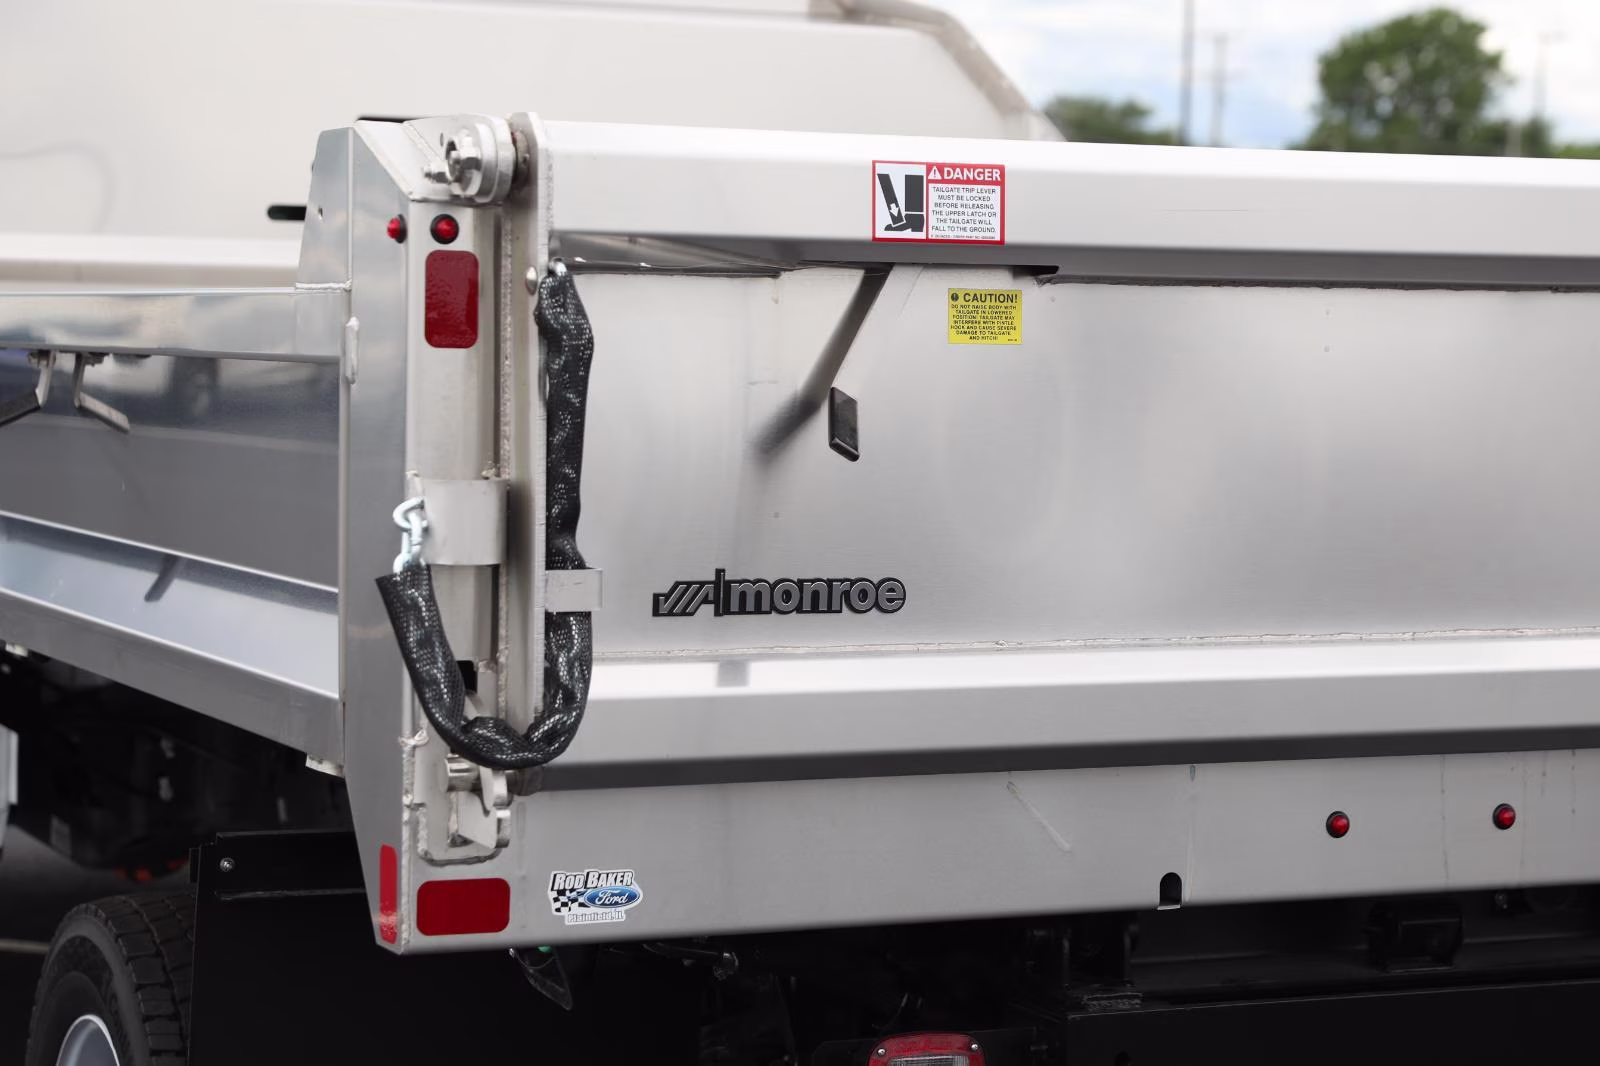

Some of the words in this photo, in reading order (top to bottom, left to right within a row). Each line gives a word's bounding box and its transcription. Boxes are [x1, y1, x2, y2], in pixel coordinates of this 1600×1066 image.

[944, 168, 1000, 181] DANGER
[964, 293, 1017, 303] CAUTION!
[729, 577, 906, 614] monroe
[551, 873, 585, 891] ROD
[584, 871, 633, 889] BAKER
[595, 890, 629, 904] Ford
